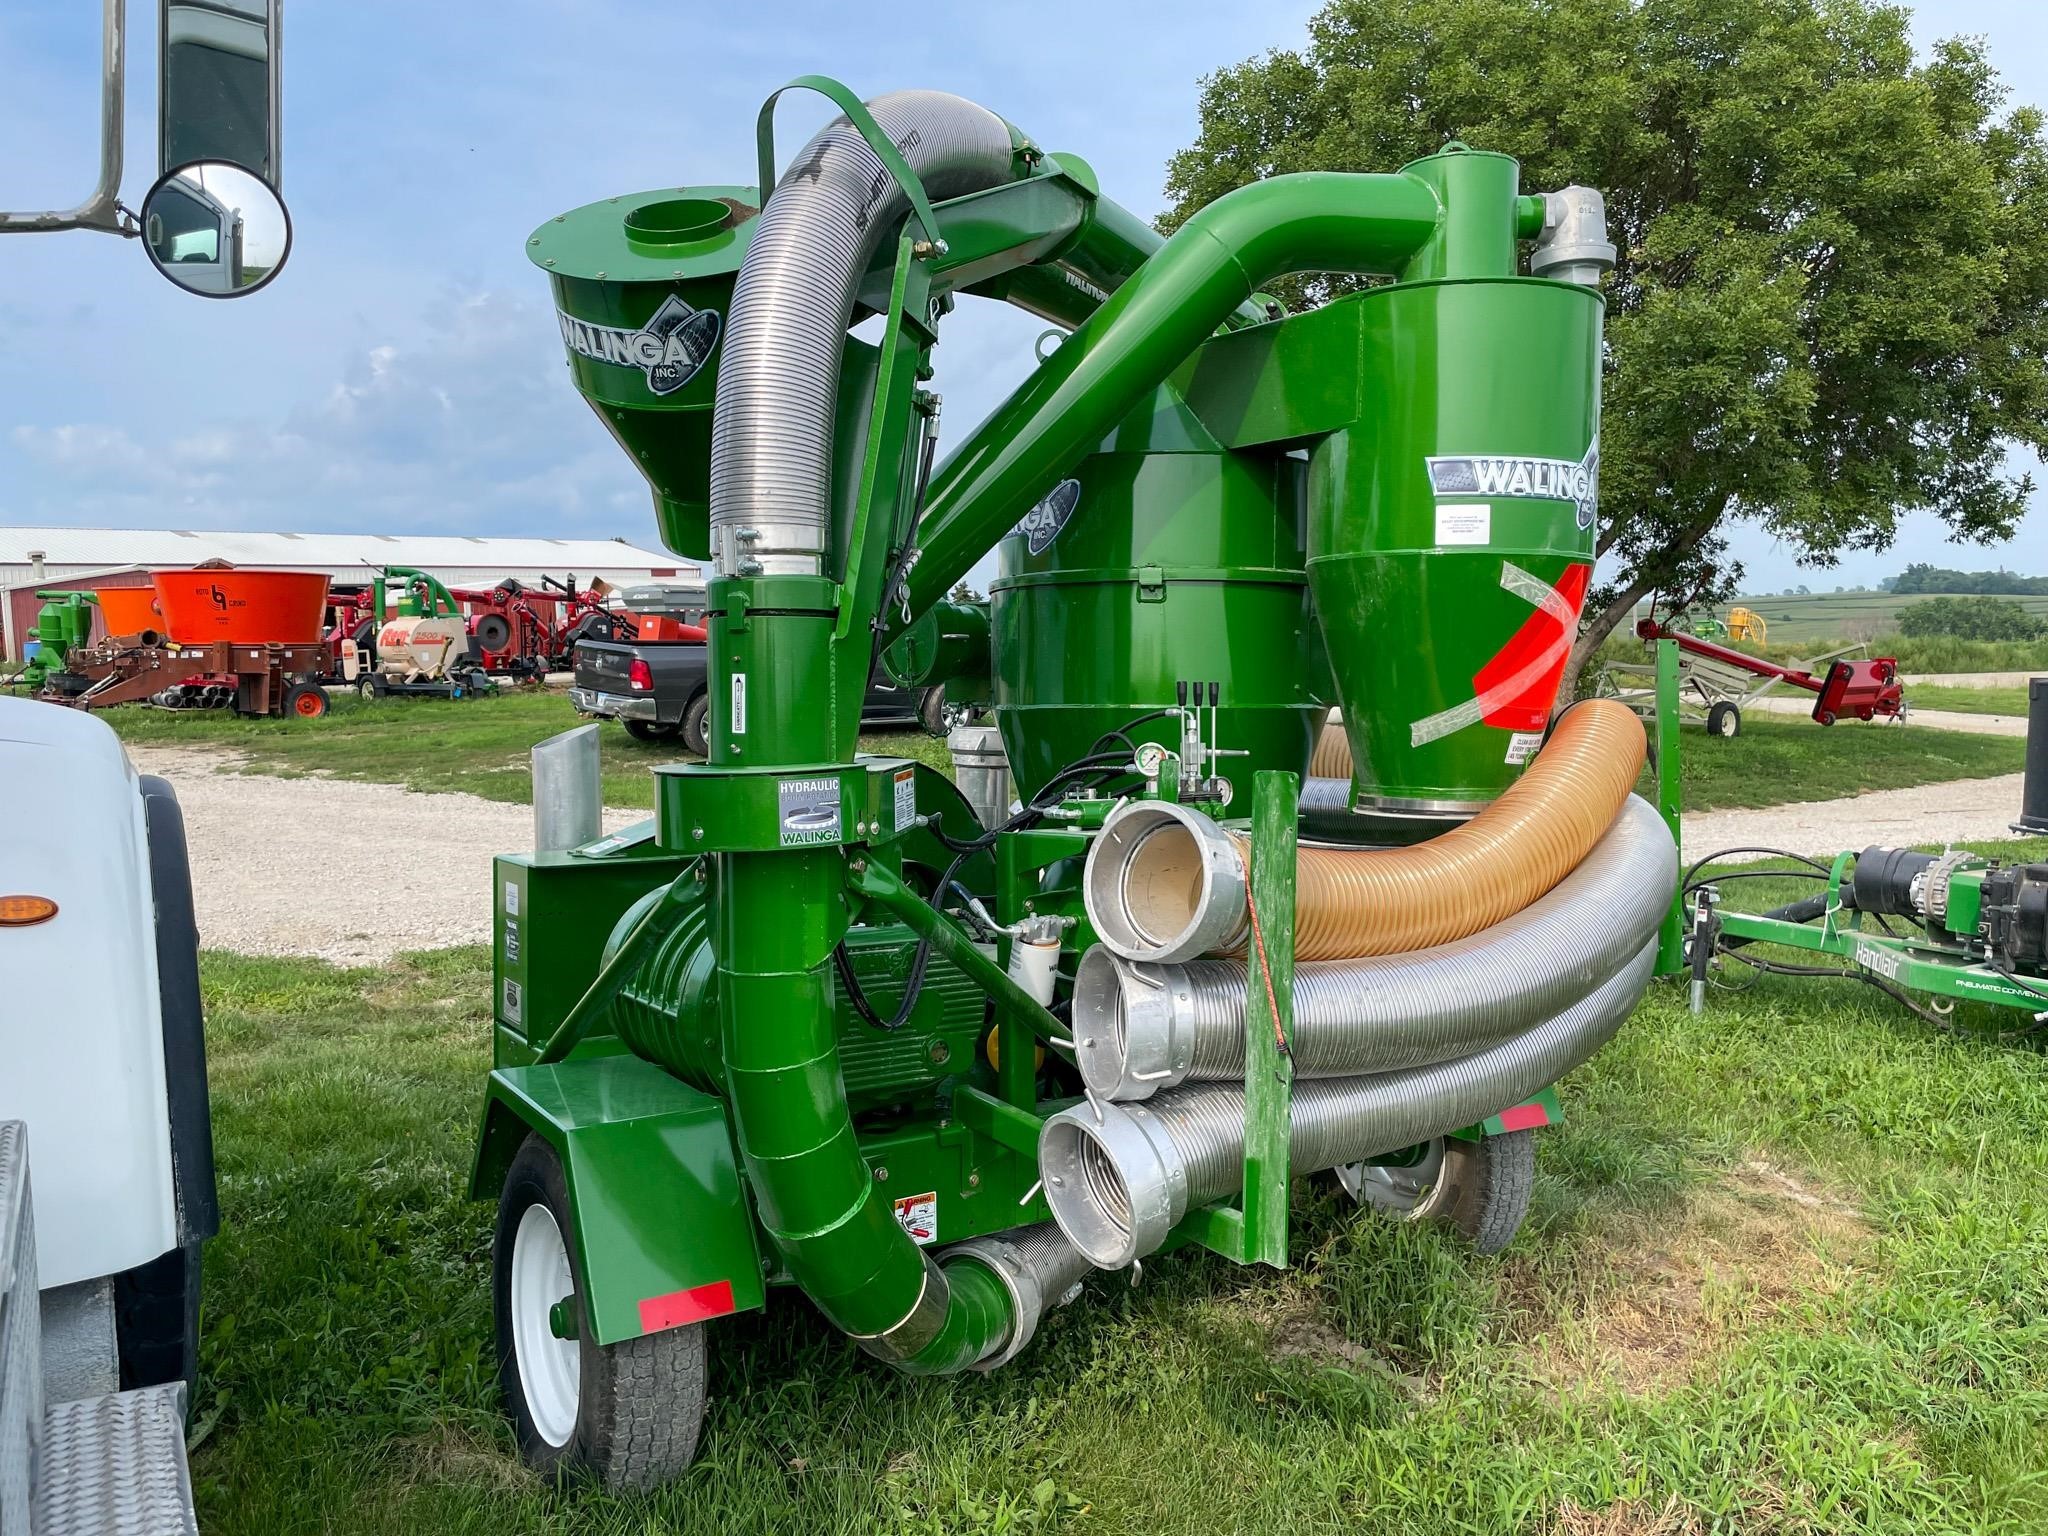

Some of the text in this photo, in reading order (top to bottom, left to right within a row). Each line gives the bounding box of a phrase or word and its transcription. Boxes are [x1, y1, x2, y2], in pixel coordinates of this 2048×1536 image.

[655, 367, 680, 379] INC.
[780, 779, 839, 794] HYDRAULIC
[782, 829, 841, 844] WALINGA
[1855, 941, 1900, 980] Handlair
[1955, 979, 2002, 993] PNEUMATIC
